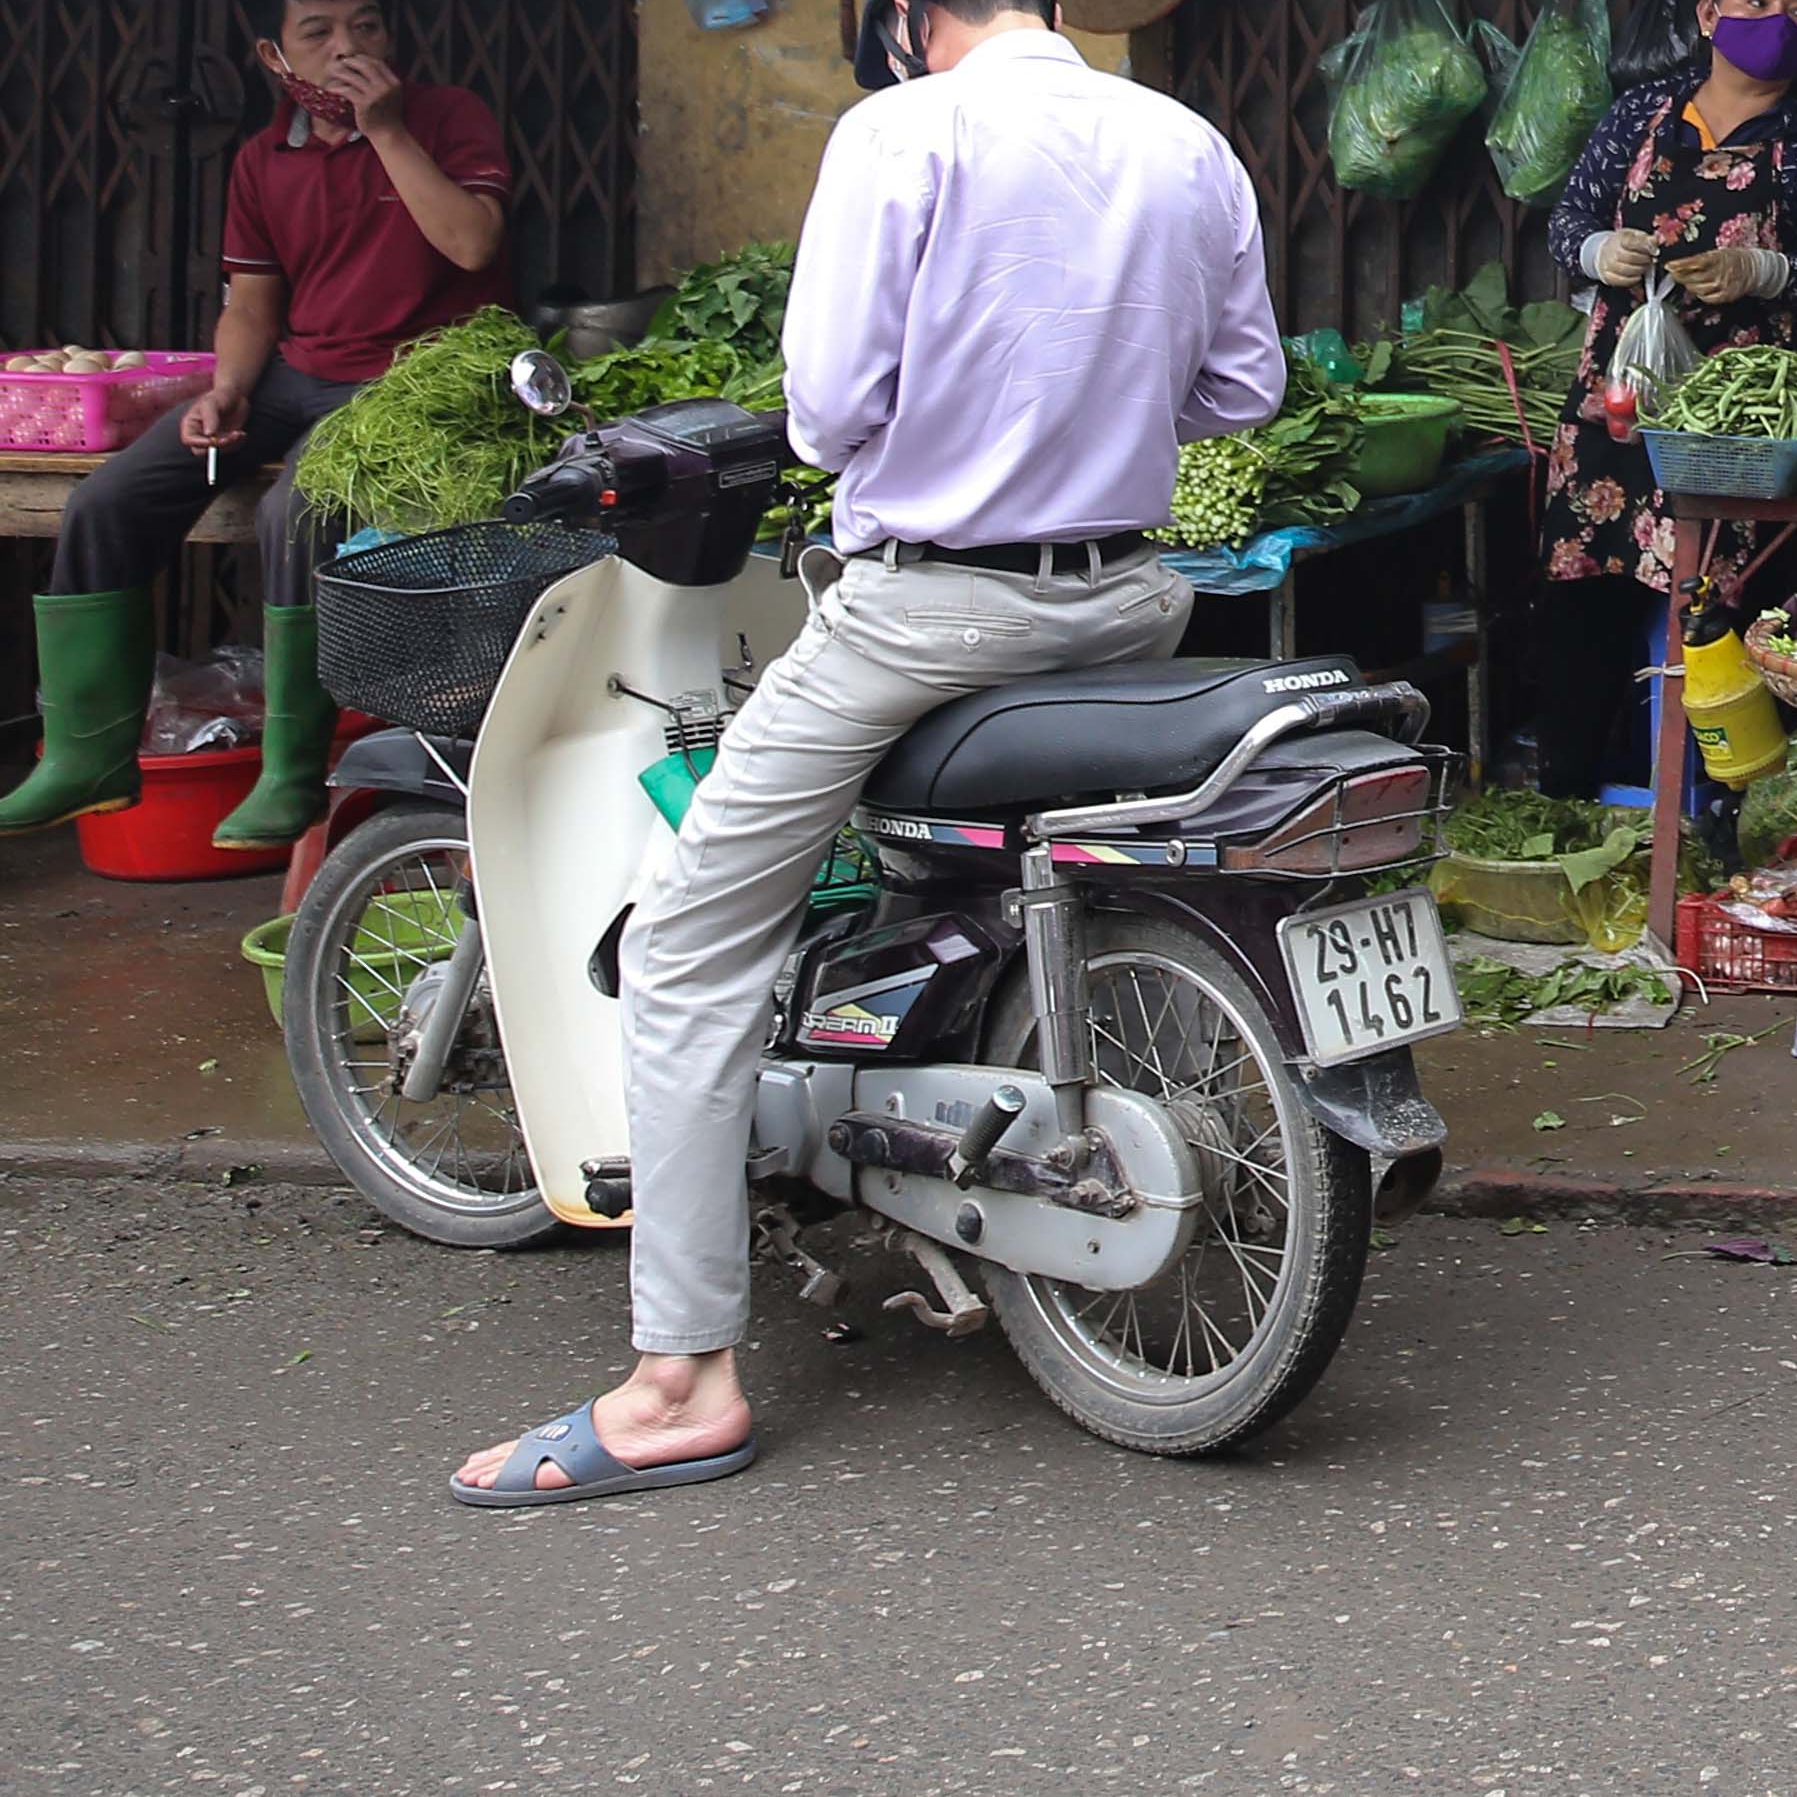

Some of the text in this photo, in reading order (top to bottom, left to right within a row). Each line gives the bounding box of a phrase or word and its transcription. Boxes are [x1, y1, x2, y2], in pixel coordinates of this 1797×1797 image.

[1264, 668, 1350, 695] HONDA
[865, 816, 934, 841] HONDA
[1306, 902, 1416, 987] 29-H7
[1326, 965, 1441, 1046] 1462
[803, 1010, 879, 1037] DREAM
